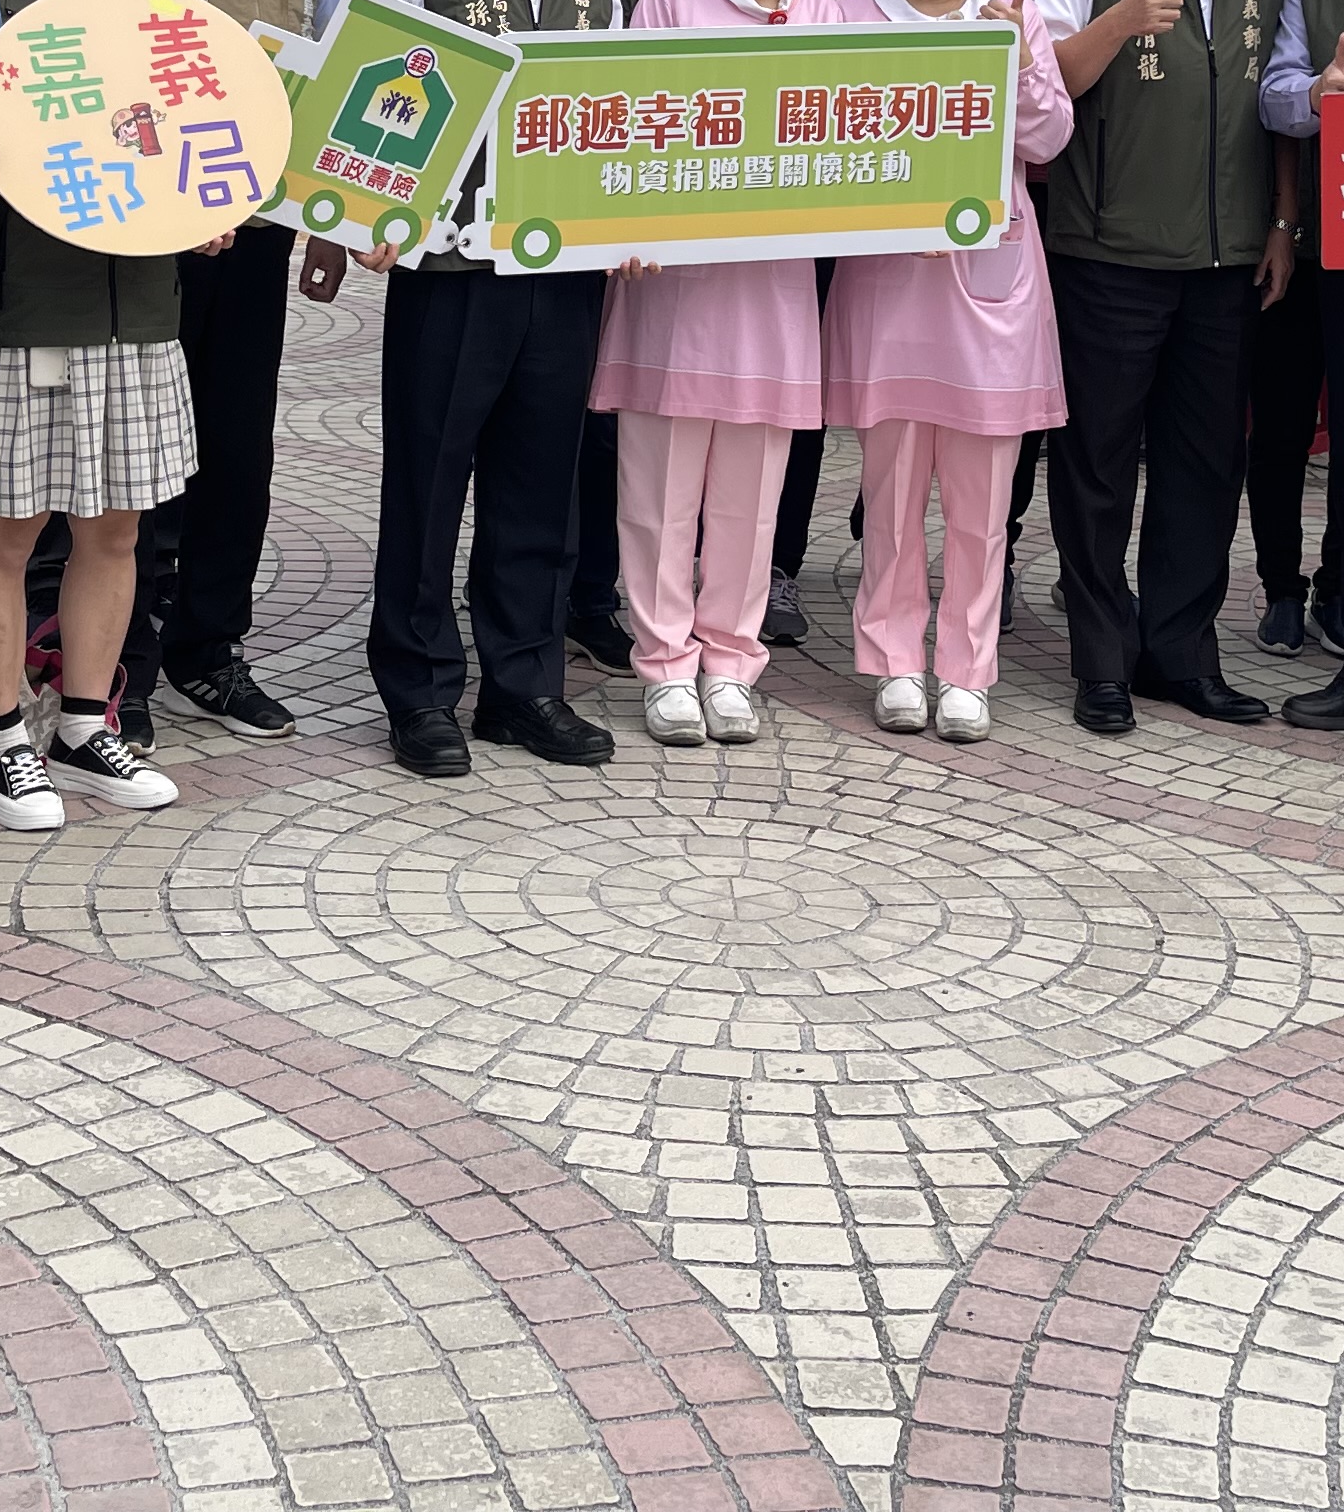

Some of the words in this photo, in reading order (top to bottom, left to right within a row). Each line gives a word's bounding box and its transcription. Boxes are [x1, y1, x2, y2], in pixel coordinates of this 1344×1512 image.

[17, 9, 227, 122] 嘉義
[515, 90, 745, 154] 郵遞幸福
[777, 82, 995, 145] 關懷列車
[43, 120, 263, 232] 郵局
[314, 145, 420, 202] 郵政壽險
[600, 149, 913, 196] 物資捐贈暨關懷活動
